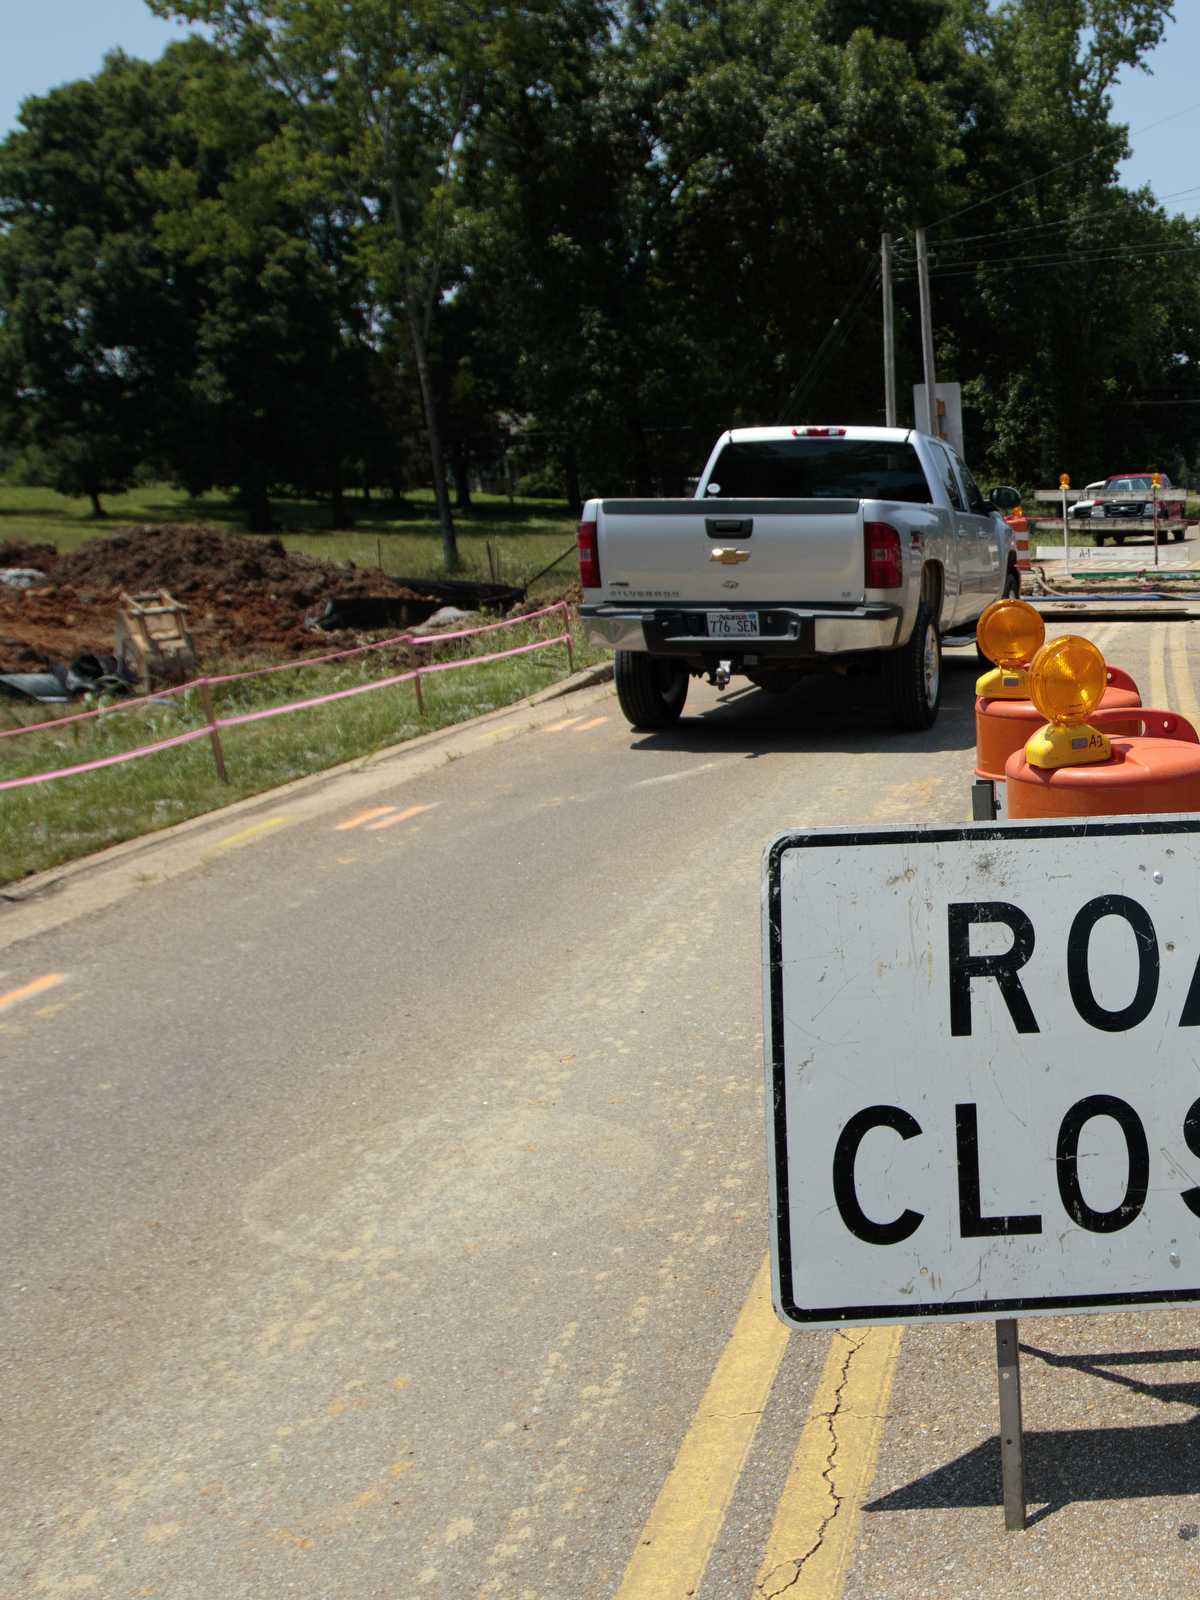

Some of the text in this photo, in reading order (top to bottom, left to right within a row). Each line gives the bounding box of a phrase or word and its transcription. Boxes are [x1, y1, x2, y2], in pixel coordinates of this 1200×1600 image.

[719, 613, 747, 621] Arkansas
[710, 620, 758, 633] 776 SEN
[1089, 734, 1104, 749] A-1
